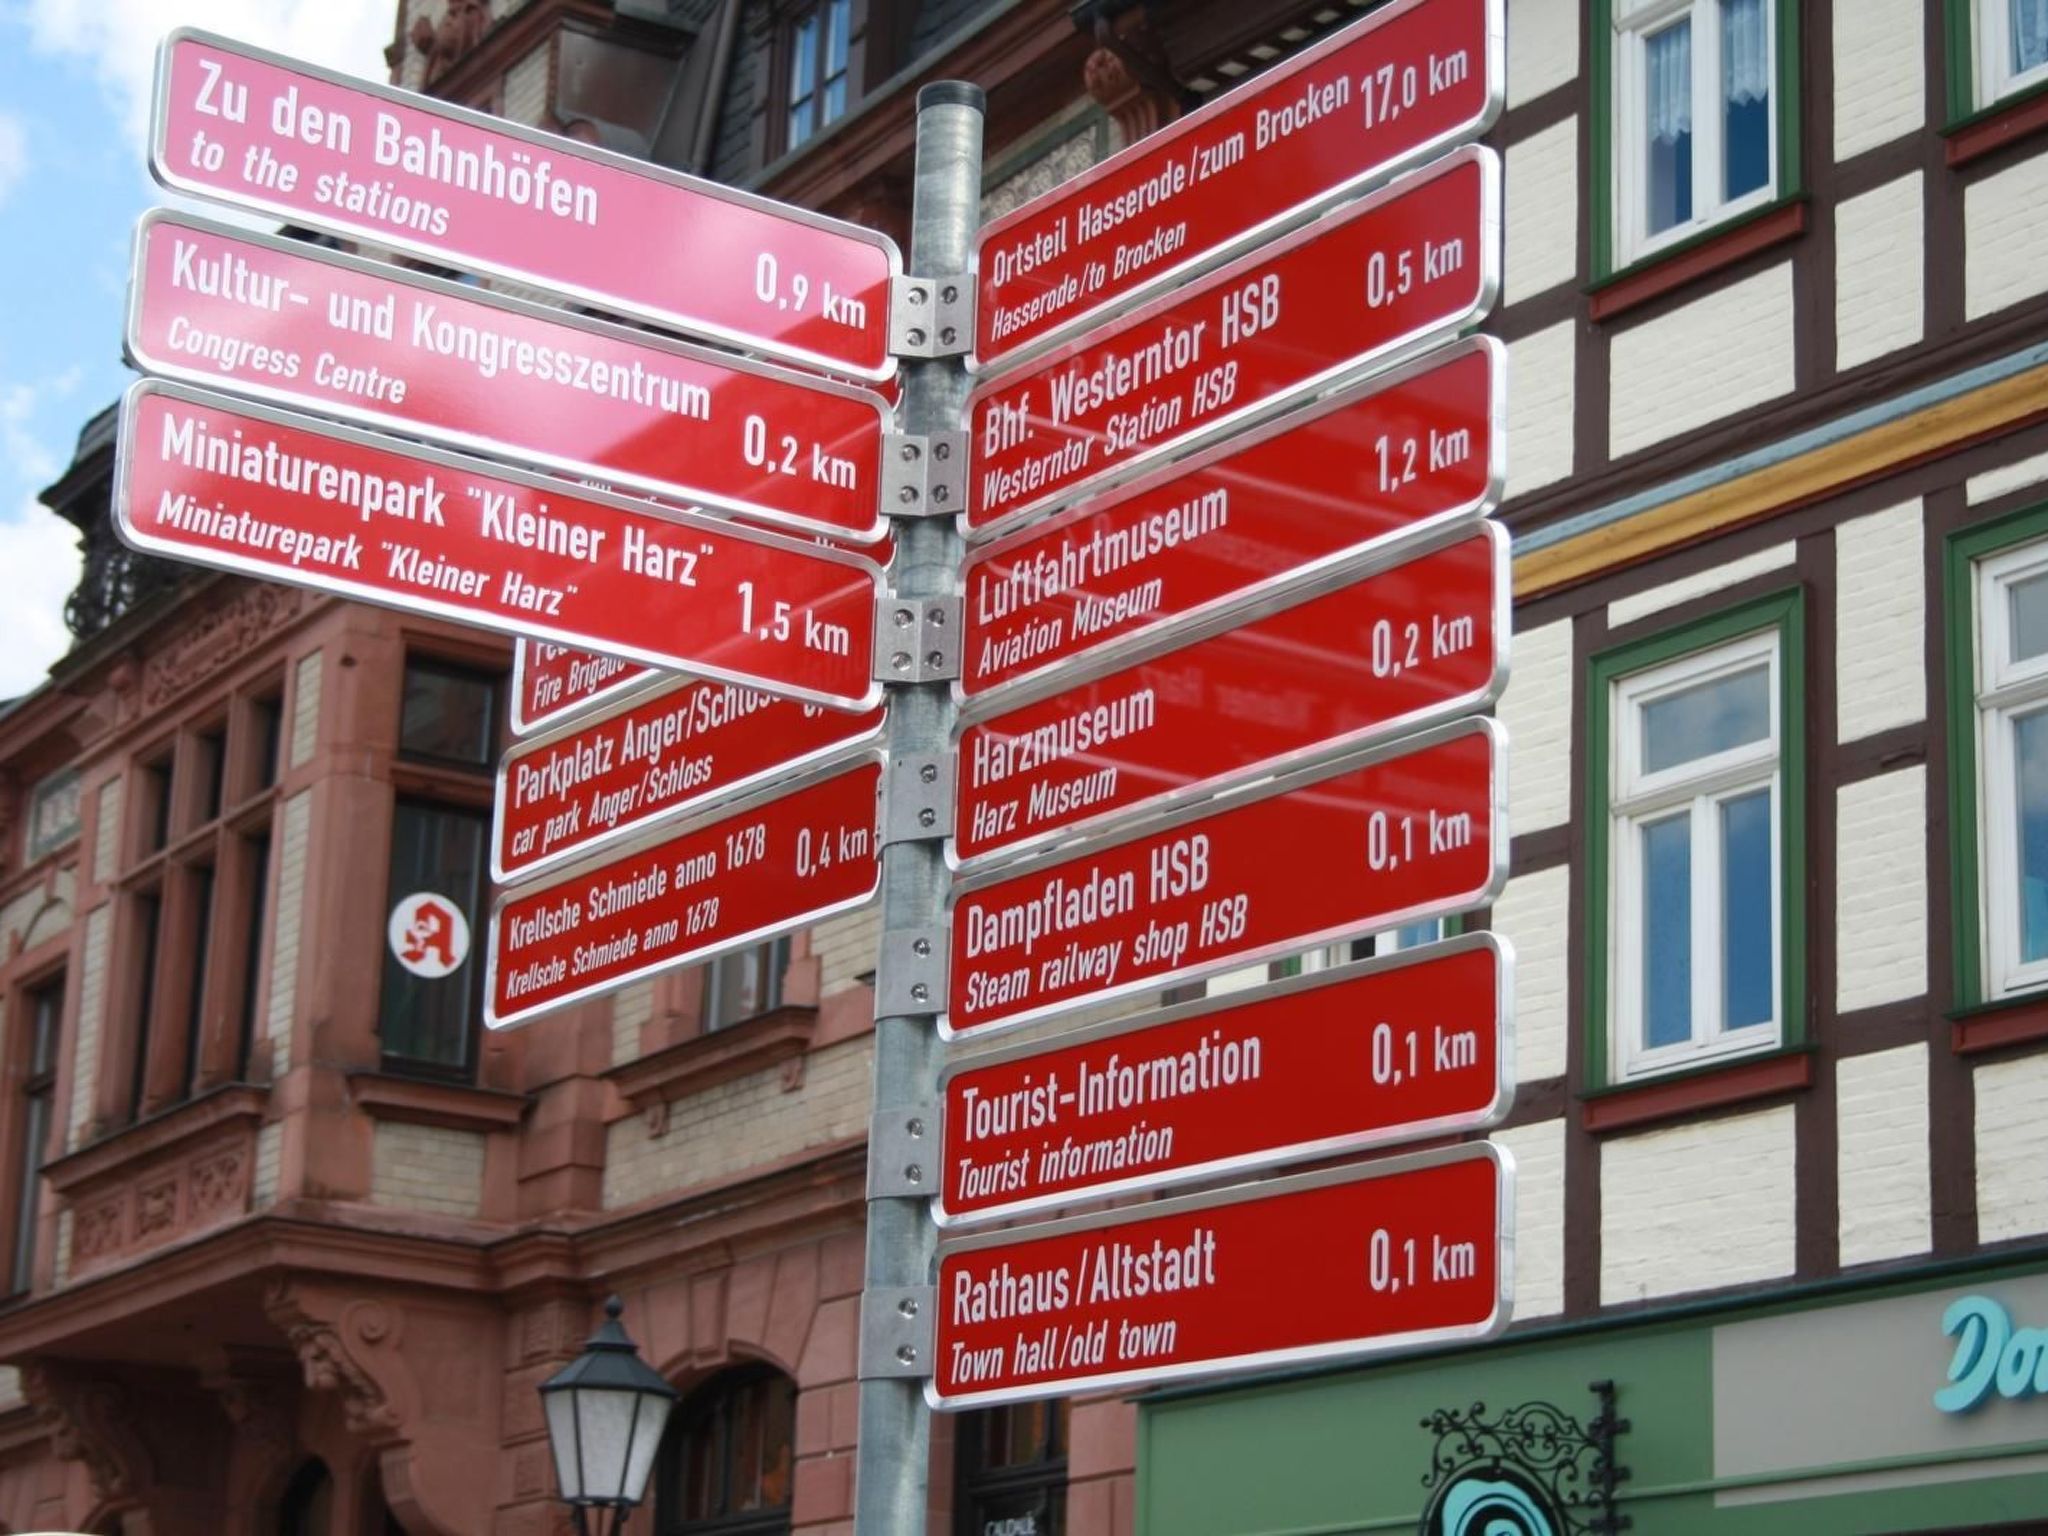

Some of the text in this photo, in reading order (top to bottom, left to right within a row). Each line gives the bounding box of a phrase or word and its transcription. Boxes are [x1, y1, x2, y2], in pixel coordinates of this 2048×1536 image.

[1361, 50, 1466, 129] 17,0 km
[192, 131, 449, 234] to the stations
[195, 60, 597, 230] Zu den Bahnhöfen
[993, 217, 1066, 287] Ortsteil
[1256, 76, 1349, 150] Brocken
[1114, 222, 1186, 279] Brocken
[1368, 239, 1461, 308] 0,5 km
[173, 240, 710, 420] Kultur- und Kongresszentrum
[756, 253, 865, 329] 0,9 km
[169, 317, 406, 403] Congress Centre
[984, 274, 1279, 460] Bhf. Westerntor HSB
[158, 413, 446, 529] Miniaturenpark
[744, 414, 856, 490] 0,2 km
[984, 361, 1238, 510] Westerntor Station HSB
[1375, 429, 1468, 492] 1,2 km
[158, 490, 363, 571] Miniaturepark
[980, 488, 1227, 625] Luftfahrtmuseum
[738, 581, 849, 656] 1,5 km
[978, 578, 1162, 677] Aviation Museum
[1372, 615, 1472, 678] 0,2 km
[533, 675, 561, 710] Fire
[516, 736, 613, 808] Parkplatz
[974, 688, 1154, 787] Harzmuseum
[513, 825, 538, 856] car
[543, 807, 580, 852] park
[972, 764, 1119, 842] Harz Museum
[1369, 808, 1470, 870] 0,1 km
[510, 824, 765, 950] Krellsche Schmiede anno 1678
[797, 827, 867, 877] 0,4 km
[968, 835, 1209, 958] Dampfladen HSB
[507, 897, 719, 998] Krellsche Schmiede anno 1678
[966, 894, 1248, 1012] Steam railway shop HSB
[963, 1030, 1260, 1141] Tourist-Information
[1373, 1023, 1475, 1085] 0,1 km
[959, 1121, 1173, 1199] Tourist information
[1371, 1229, 1474, 1293] 0,1 km
[952, 1342, 1003, 1383] Town
[1119, 1320, 1176, 1359] town
